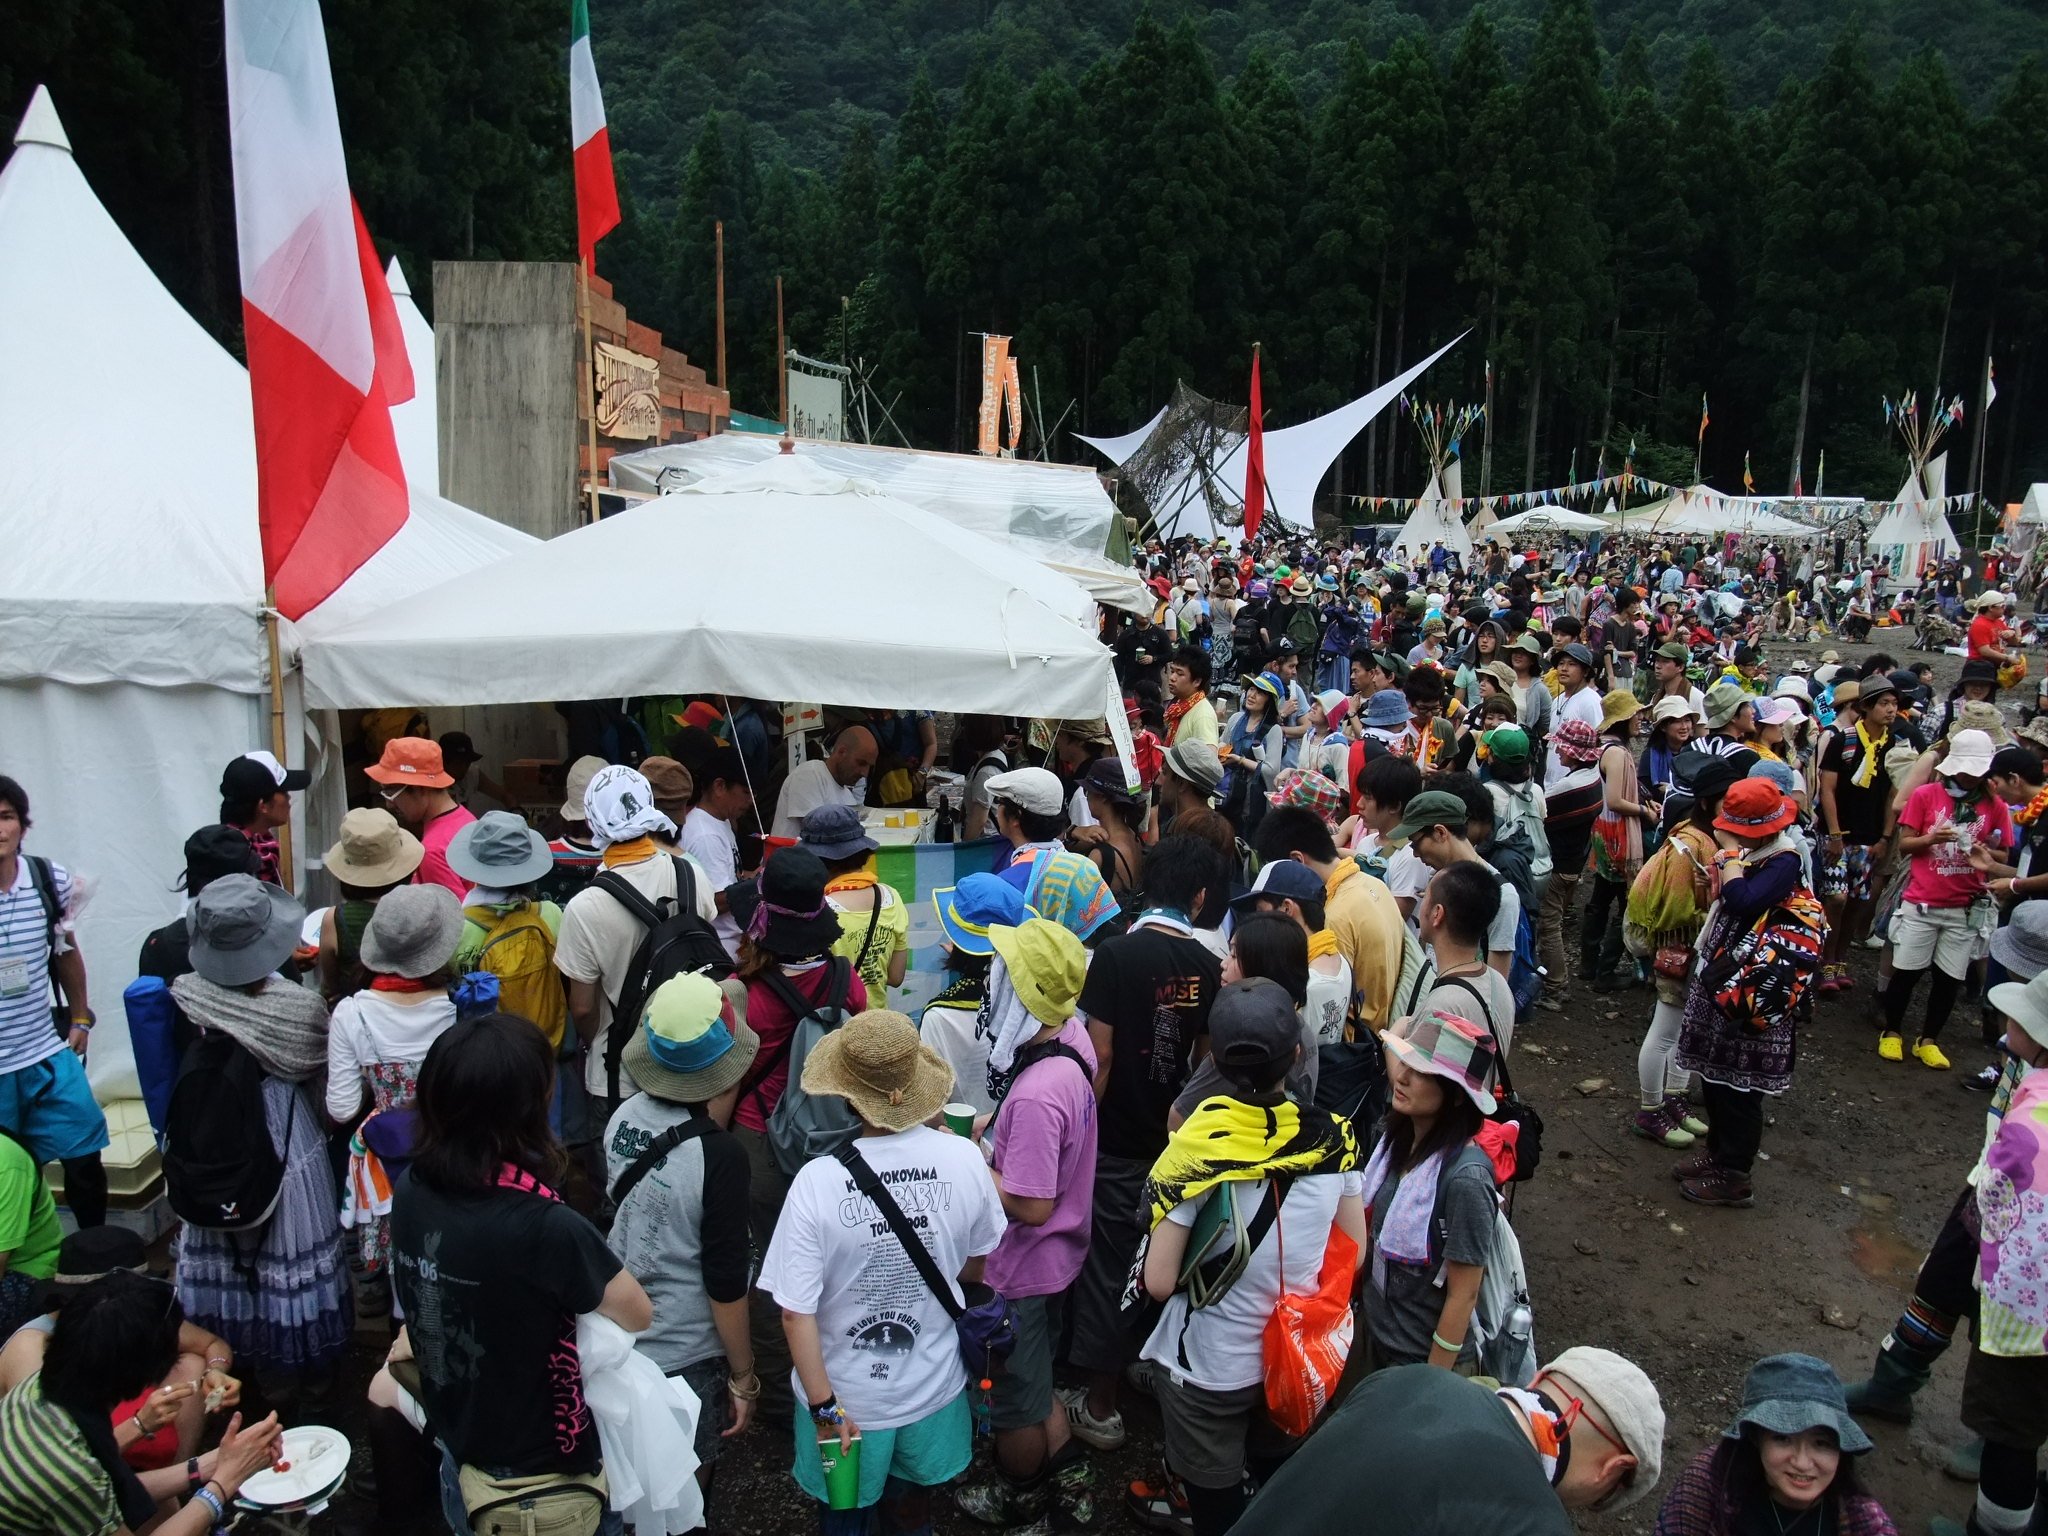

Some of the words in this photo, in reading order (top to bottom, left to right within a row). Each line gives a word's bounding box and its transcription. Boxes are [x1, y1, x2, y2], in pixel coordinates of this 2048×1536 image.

[845, 1325, 860, 1338] WE
[857, 1314, 878, 1329] LOVE
[880, 1310, 897, 1321] YOU
